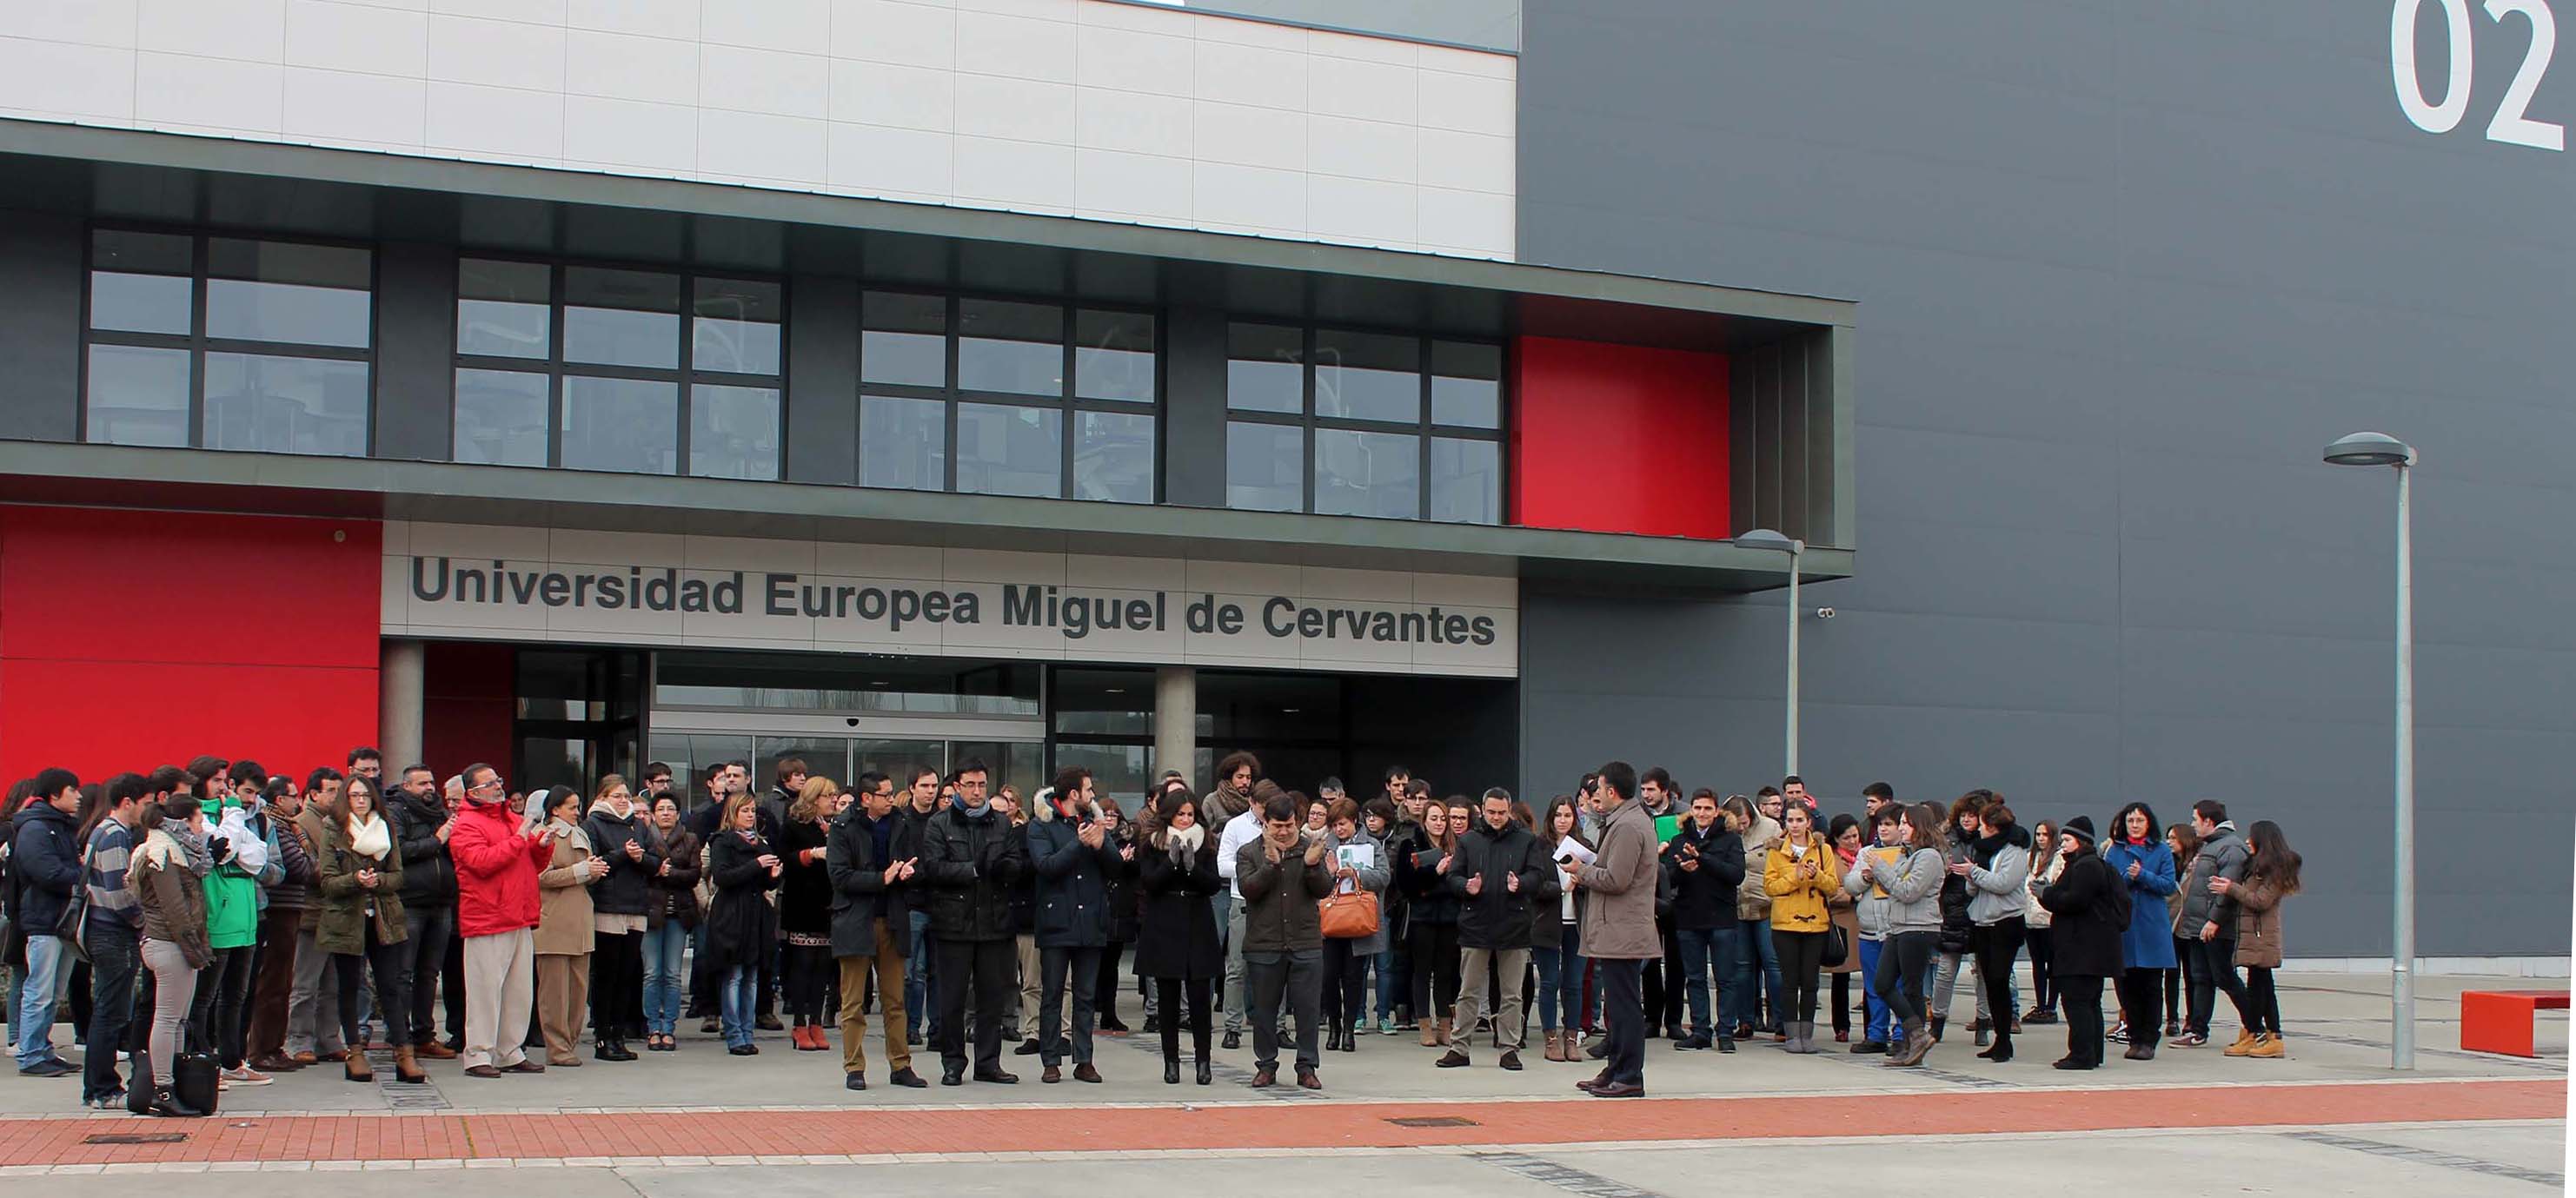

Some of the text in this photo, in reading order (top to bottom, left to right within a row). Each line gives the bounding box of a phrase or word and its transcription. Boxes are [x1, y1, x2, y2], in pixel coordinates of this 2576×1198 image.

[2391, 0, 2565, 151] 02
[411, 557, 1496, 645] Universidad Europea Miguel de Cervantes
